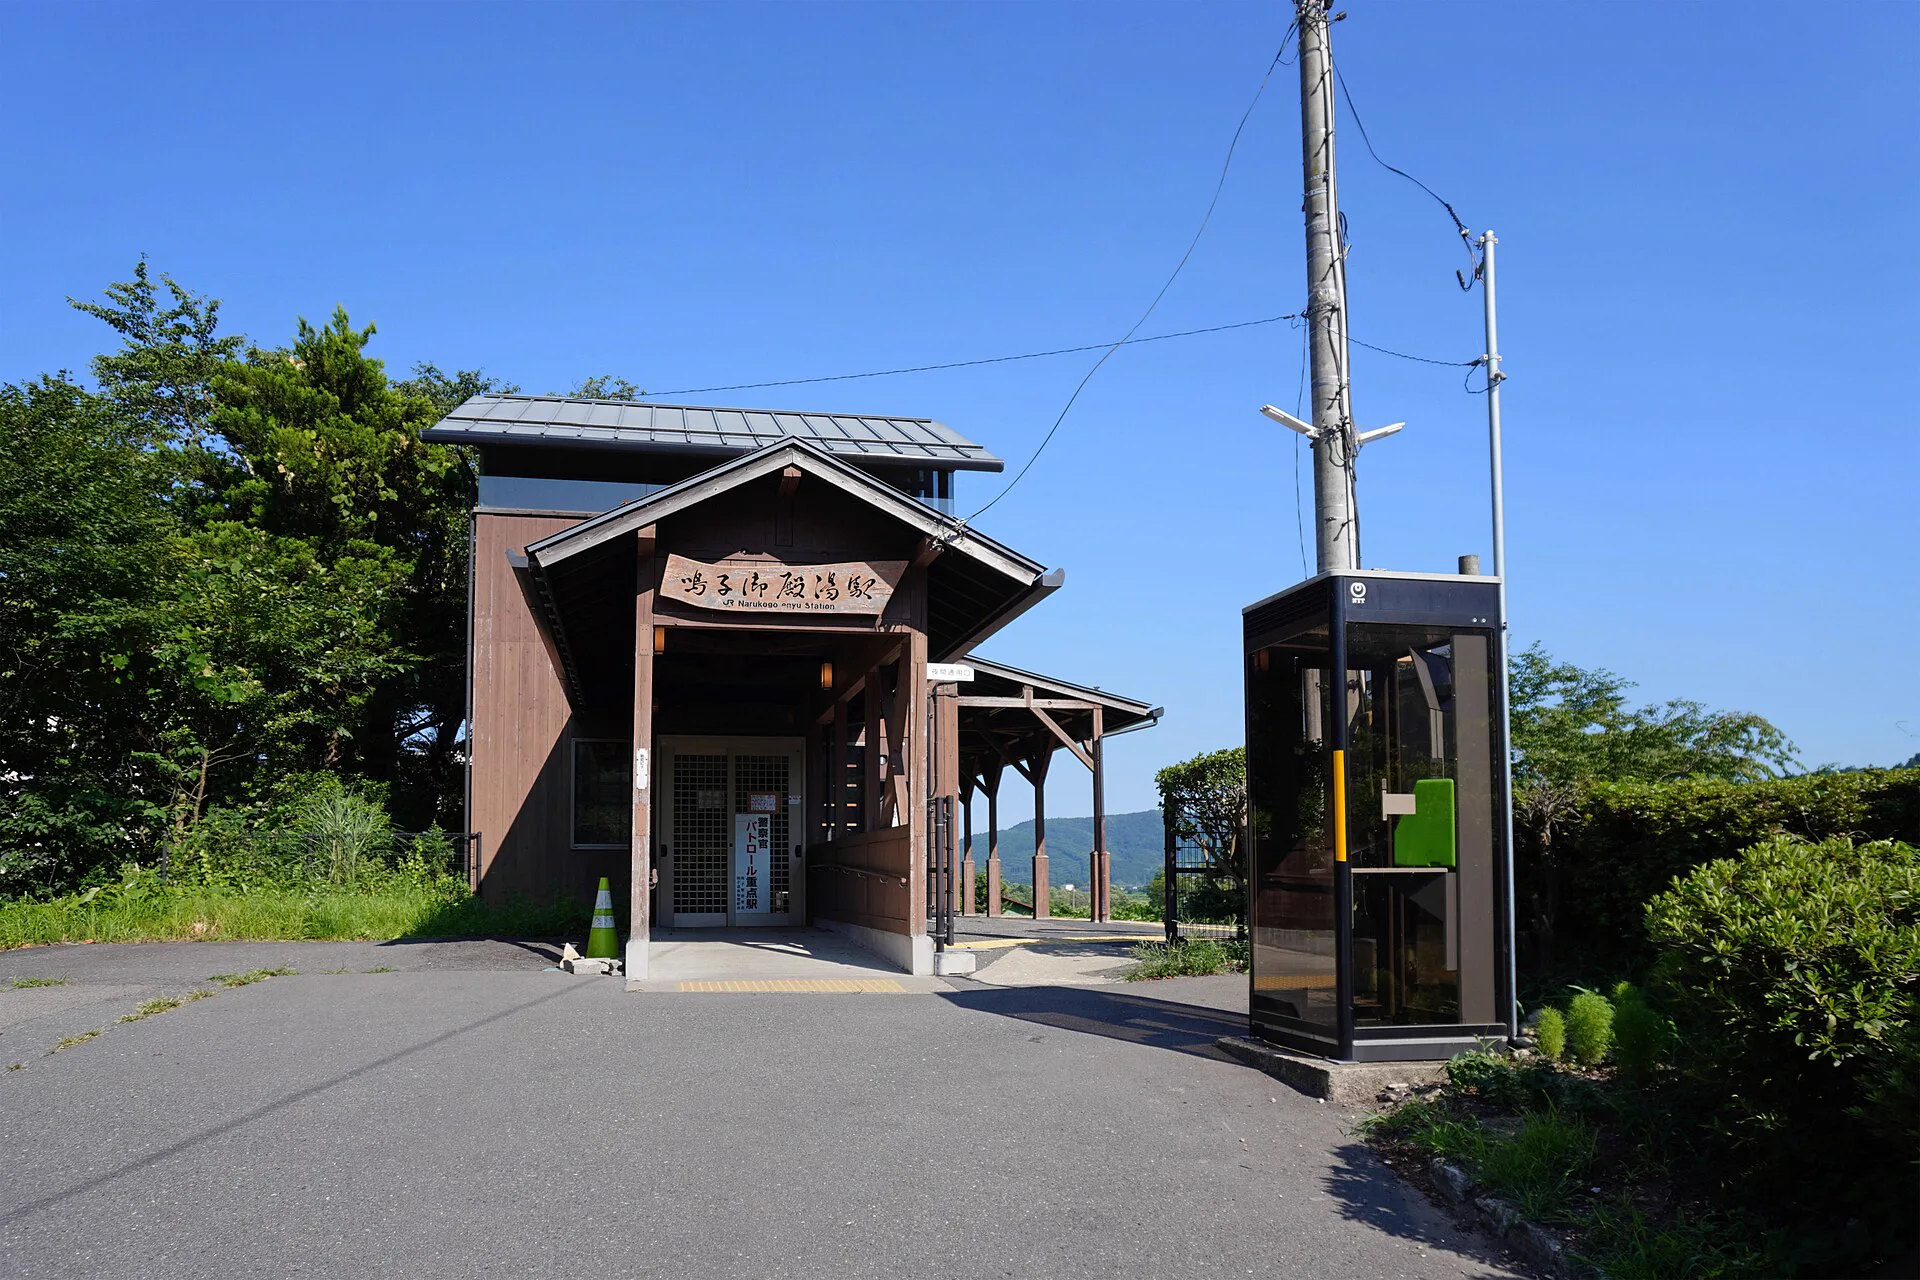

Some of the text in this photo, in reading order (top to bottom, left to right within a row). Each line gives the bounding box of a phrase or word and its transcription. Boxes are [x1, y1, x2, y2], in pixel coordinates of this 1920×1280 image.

[681, 570, 876, 600] 鳴子御殿湯駅
[758, 817, 769, 849] 警察官
[746, 822, 757, 910] パトロール重点駅
